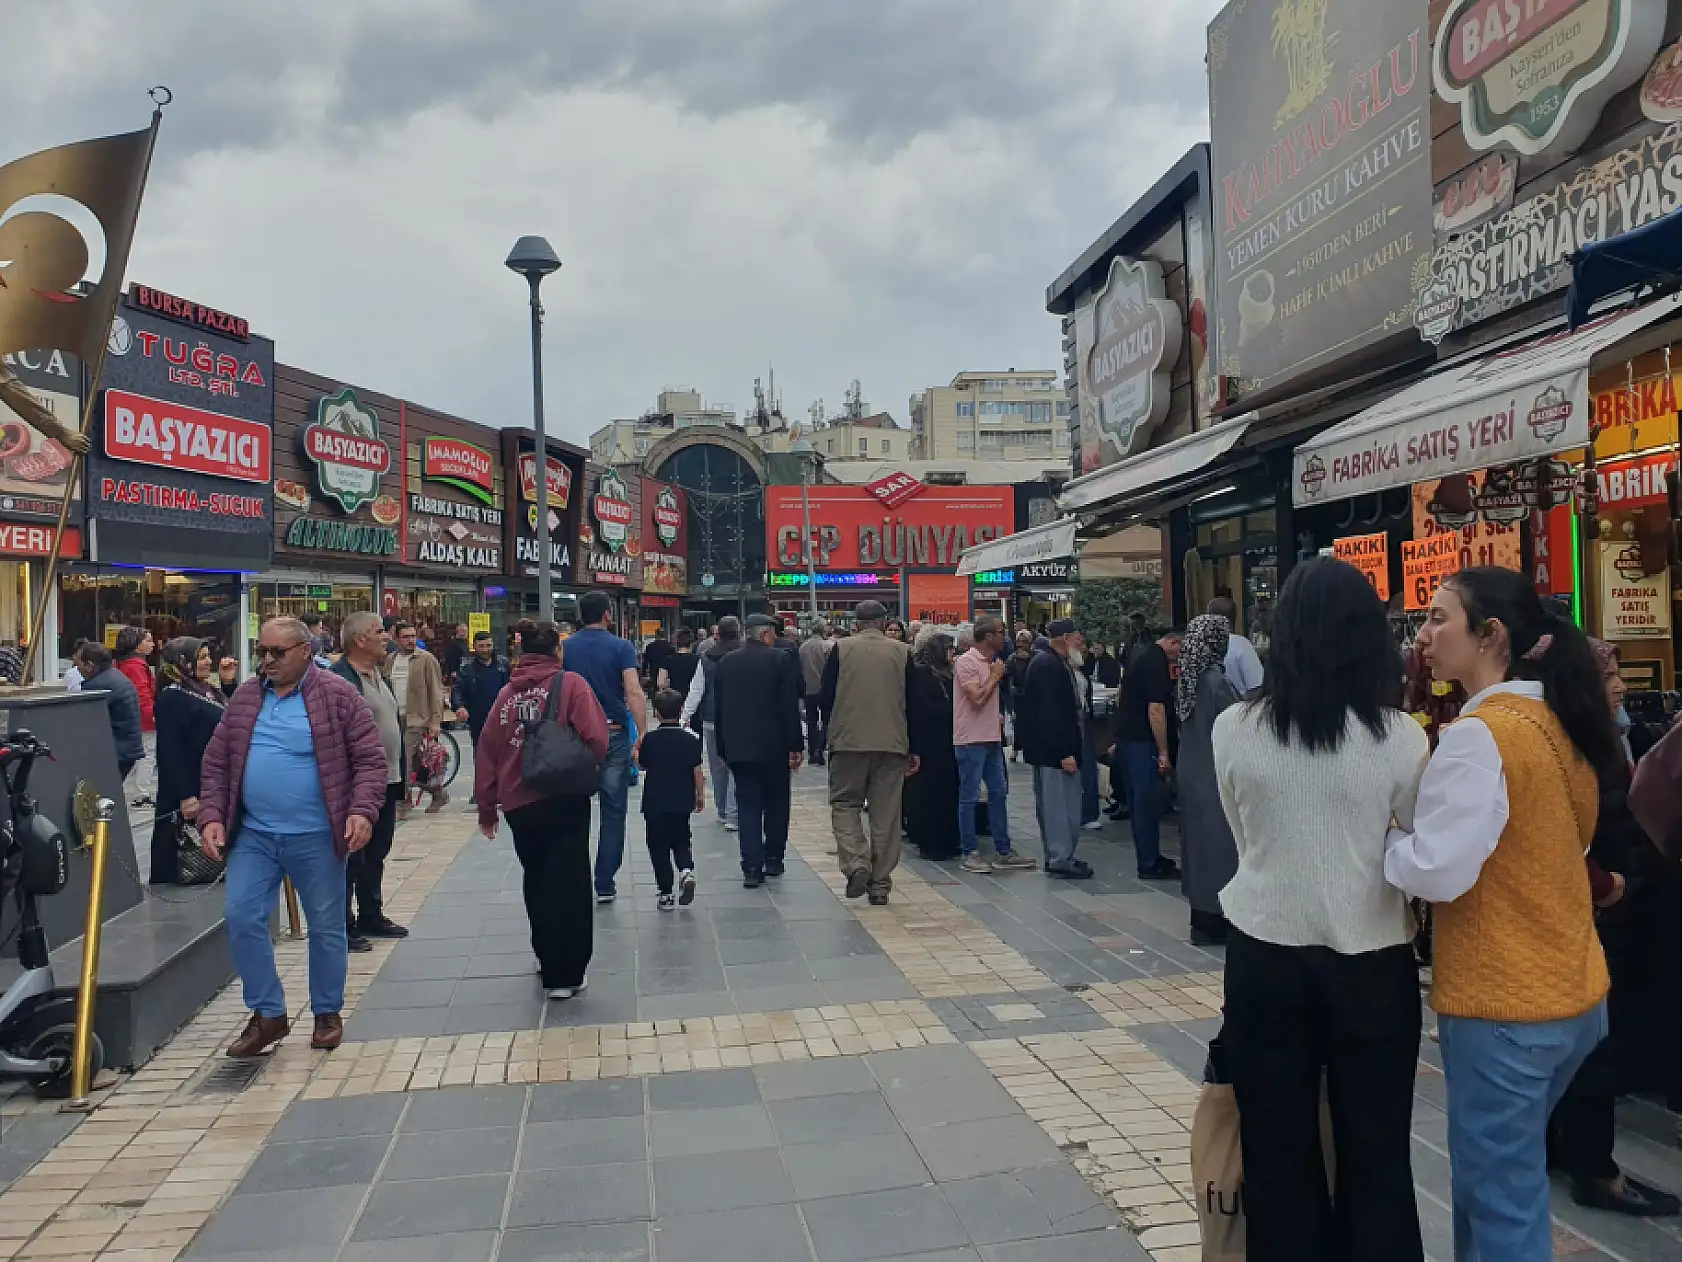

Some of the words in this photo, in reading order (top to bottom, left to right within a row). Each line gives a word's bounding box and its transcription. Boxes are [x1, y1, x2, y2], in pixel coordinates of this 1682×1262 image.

[1222, 28, 1420, 233] KAHYAOĞLU
[1530, 94, 1559, 123] 1953
[1227, 216, 1281, 270] YEMEN
[1285, 175, 1338, 232] KURU
[1344, 119, 1421, 195] KAHVE
[1363, 232, 1414, 275] KAHVE
[139, 285, 193, 322] BURSA
[198, 304, 249, 339] PAZARI
[137, 329, 266, 386] TUĞRA
[115, 407, 259, 468] BAŞYAZICI
[314, 431, 383, 465] BAŞYAZICI
[1406, 424, 1460, 464] SATIŞ
[1468, 399, 1516, 450] YERİ
[102, 477, 264, 518] PASTIRMA-SUCUK
[778, 524, 841, 566] CEP
